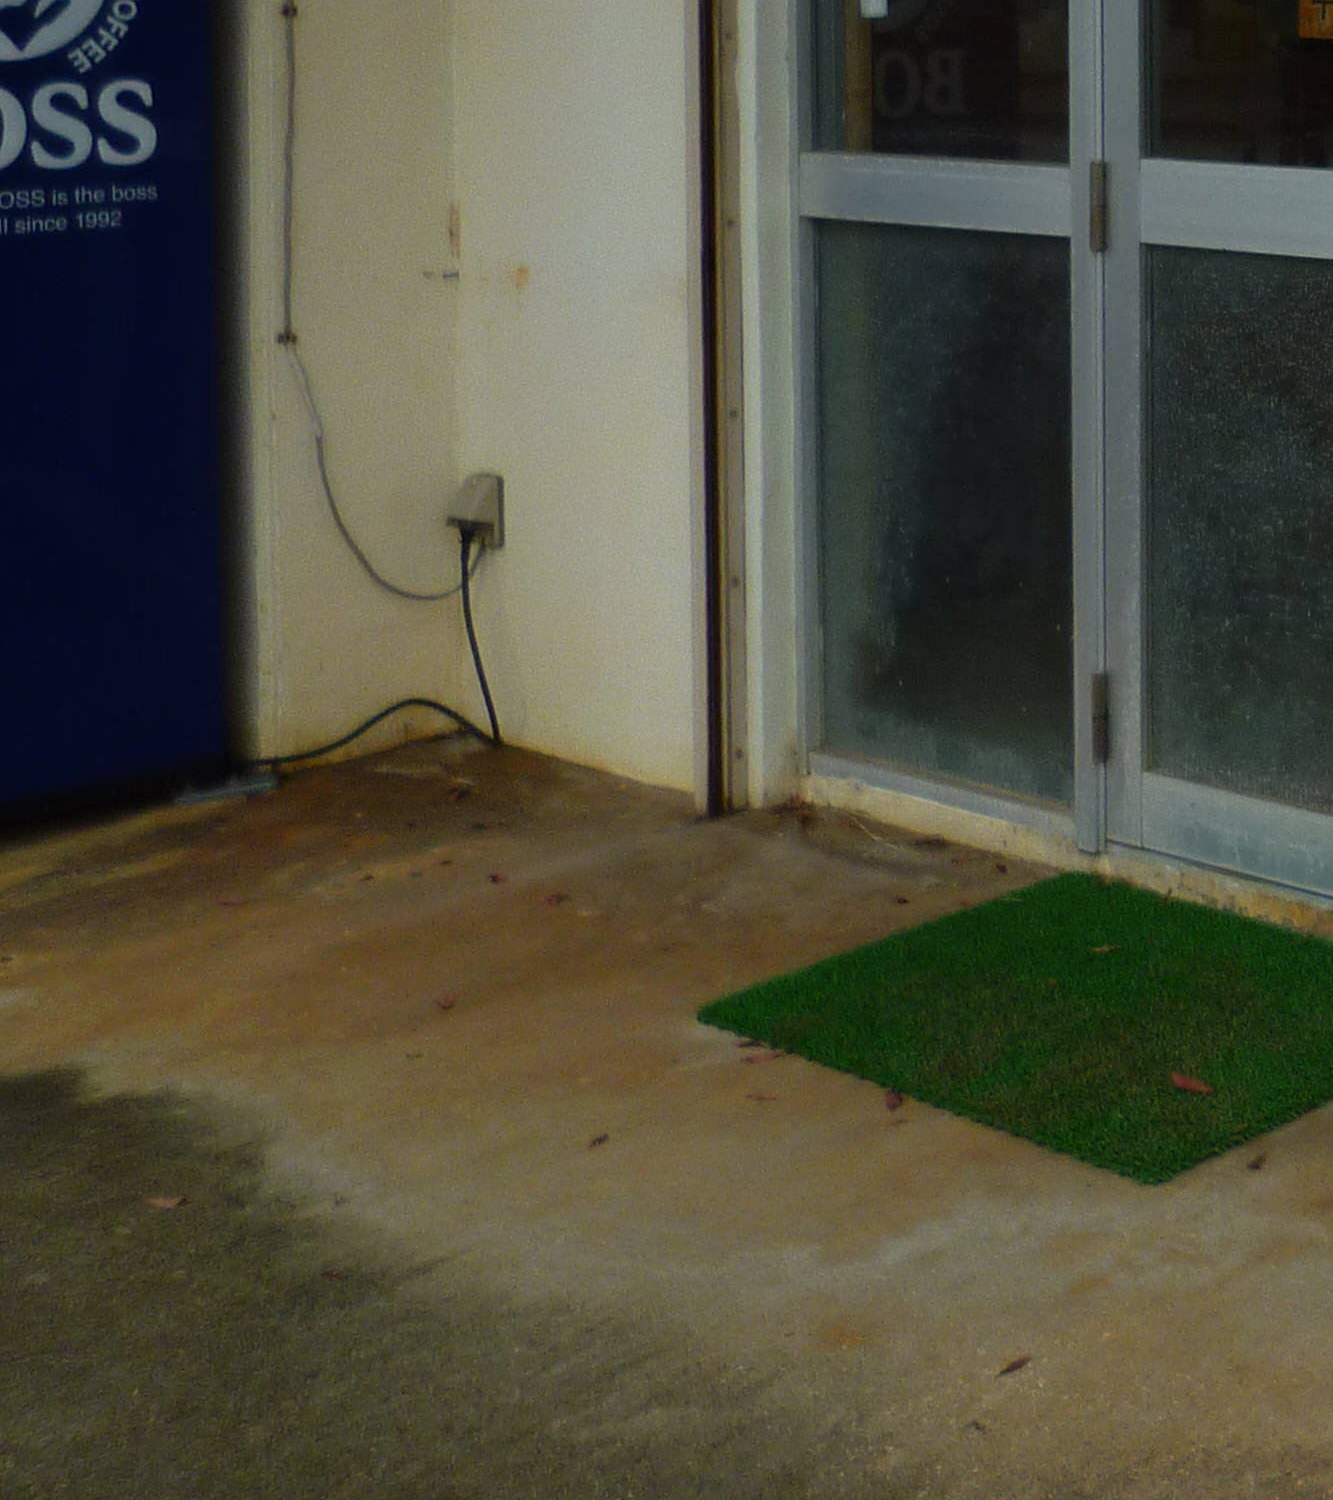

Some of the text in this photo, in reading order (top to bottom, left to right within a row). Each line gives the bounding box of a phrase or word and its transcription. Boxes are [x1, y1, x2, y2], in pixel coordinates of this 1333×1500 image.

[52, 185, 69, 206] is
[75, 185, 106, 204] the
[111, 184, 158, 203] boss
[14, 216, 68, 234] since
[75, 210, 123, 229] 1992
